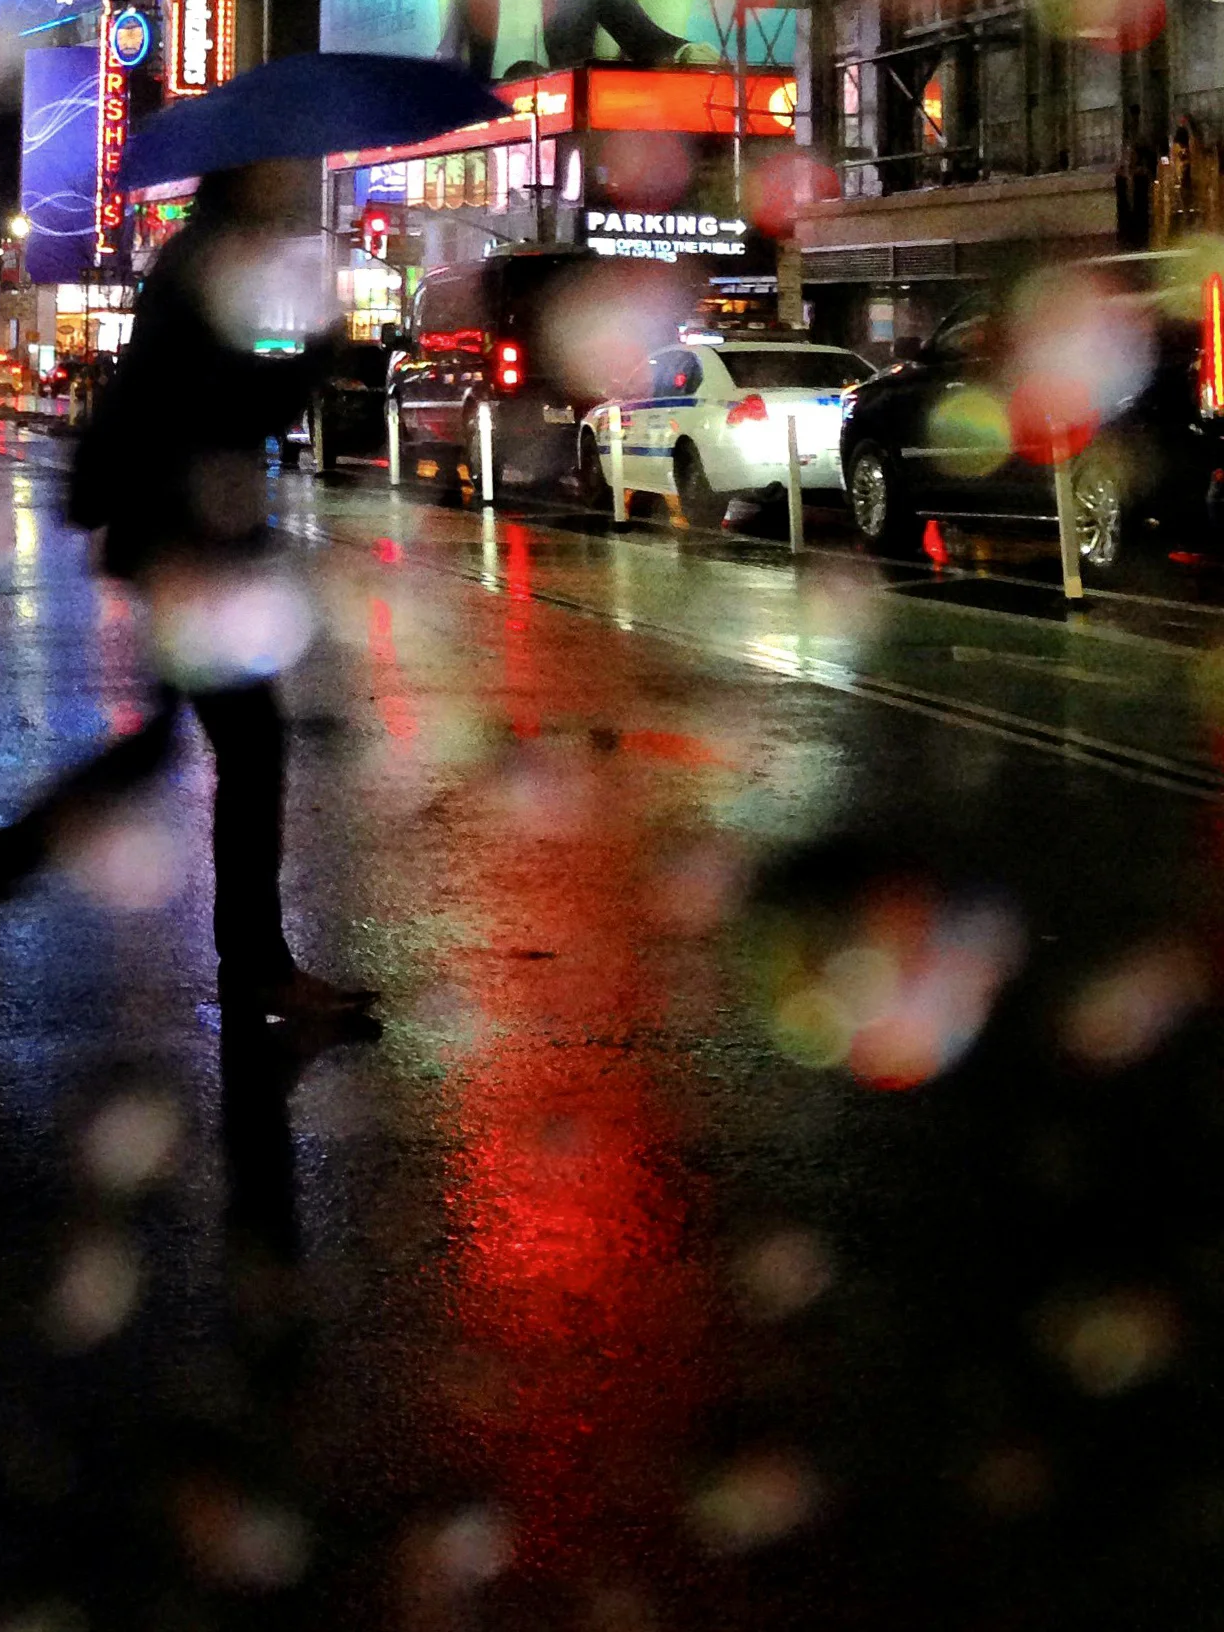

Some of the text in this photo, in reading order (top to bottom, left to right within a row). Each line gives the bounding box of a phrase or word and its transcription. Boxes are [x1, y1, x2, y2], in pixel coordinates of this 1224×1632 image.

[587, 211, 719, 236] PARKING
[616, 238, 651, 252] OPEN
[652, 240, 671, 253] TO
[671, 241, 698, 254] THE
[699, 242, 746, 255] PUBLIC
